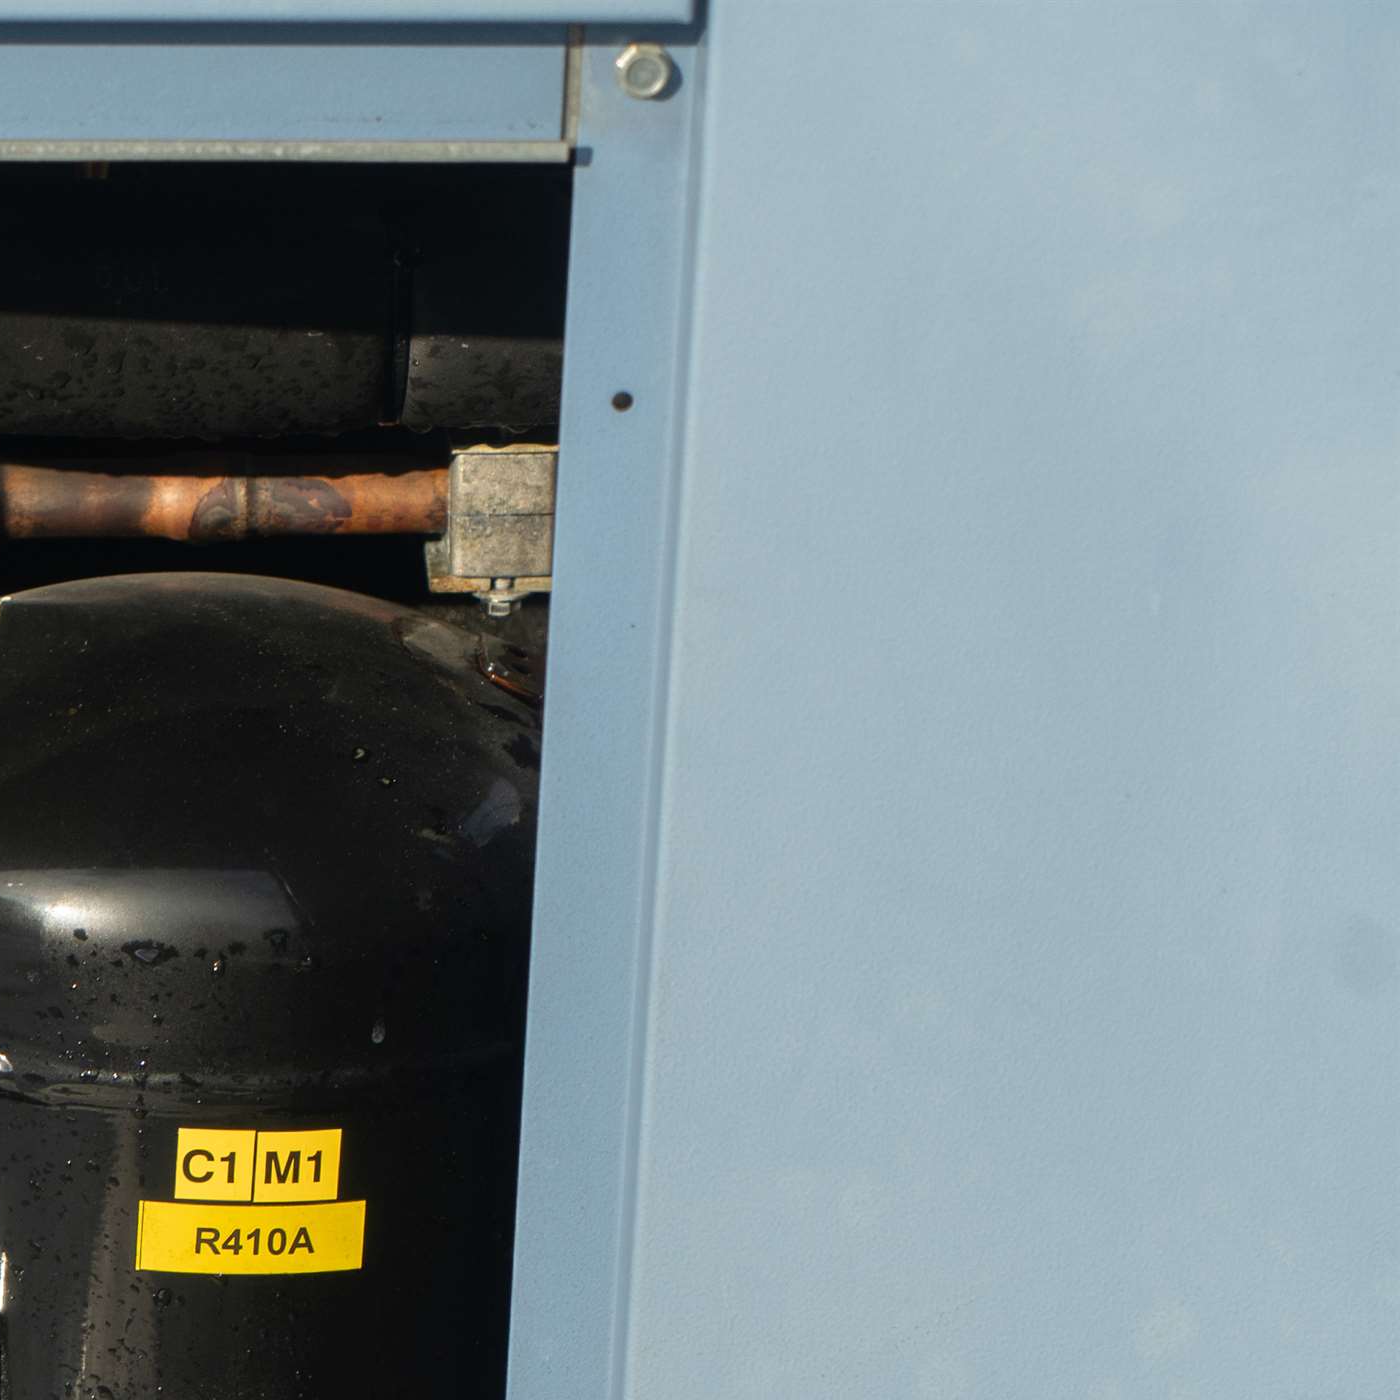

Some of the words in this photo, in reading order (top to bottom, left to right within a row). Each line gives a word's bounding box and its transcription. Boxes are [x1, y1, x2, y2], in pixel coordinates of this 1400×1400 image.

[182, 1148, 237, 1184] C1
[264, 1149, 323, 1184] M1
[194, 1226, 315, 1256] R410A
